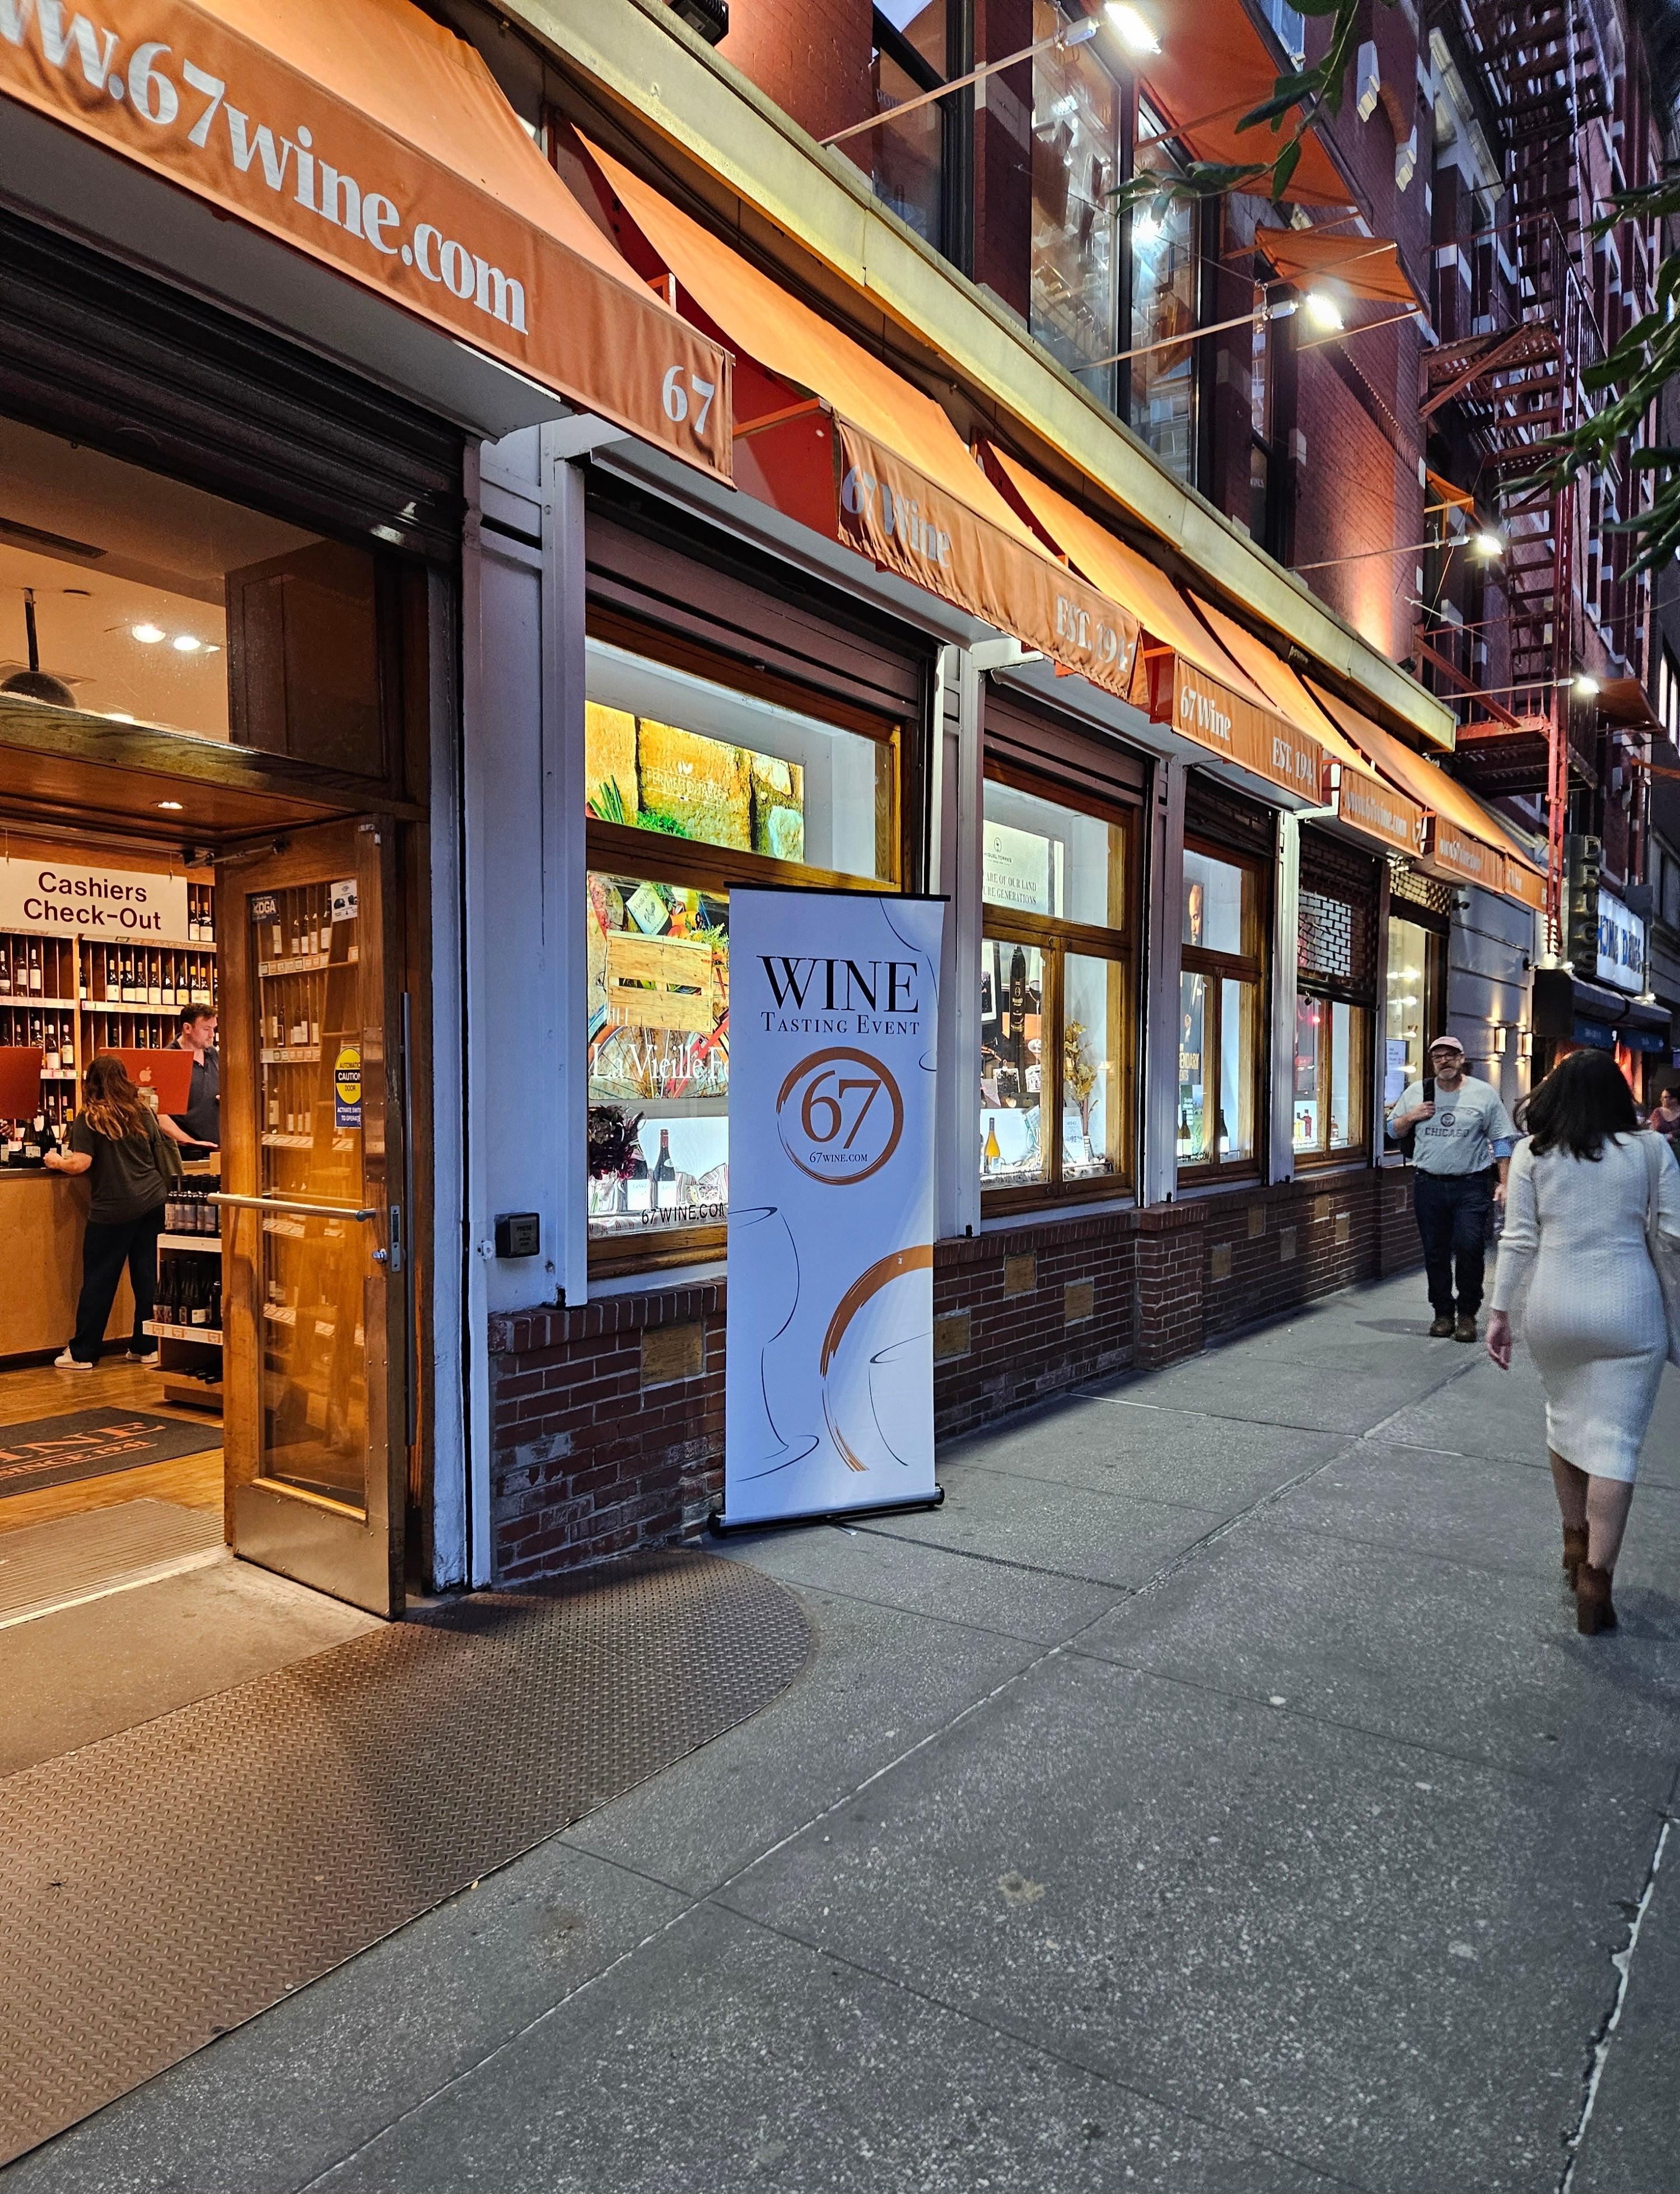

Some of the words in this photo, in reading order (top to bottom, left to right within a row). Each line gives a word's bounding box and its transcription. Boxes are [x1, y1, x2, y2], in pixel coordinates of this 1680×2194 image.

[662, 365, 715, 435] 67
[842, 465, 876, 522] 67
[881, 483, 950, 569] Wine
[1057, 594, 1092, 651] EST.
[1180, 686, 1197, 721] 67
[1197, 693, 1231, 741] Wine
[1272, 736, 1292, 774] EST.
[38, 872, 147, 902] Cashiers
[997, 888, 1037, 905] GENERATIONS
[24, 898, 161, 930] Check-Out
[253, 900, 276, 914] YOGA
[756, 955, 919, 1013] WINE
[590, 1043, 626, 1079] La
[628, 1044, 704, 1079] Vieille
[801, 1070, 882, 1149] 67
[809, 1152, 868, 1163] 67WINE.COM
